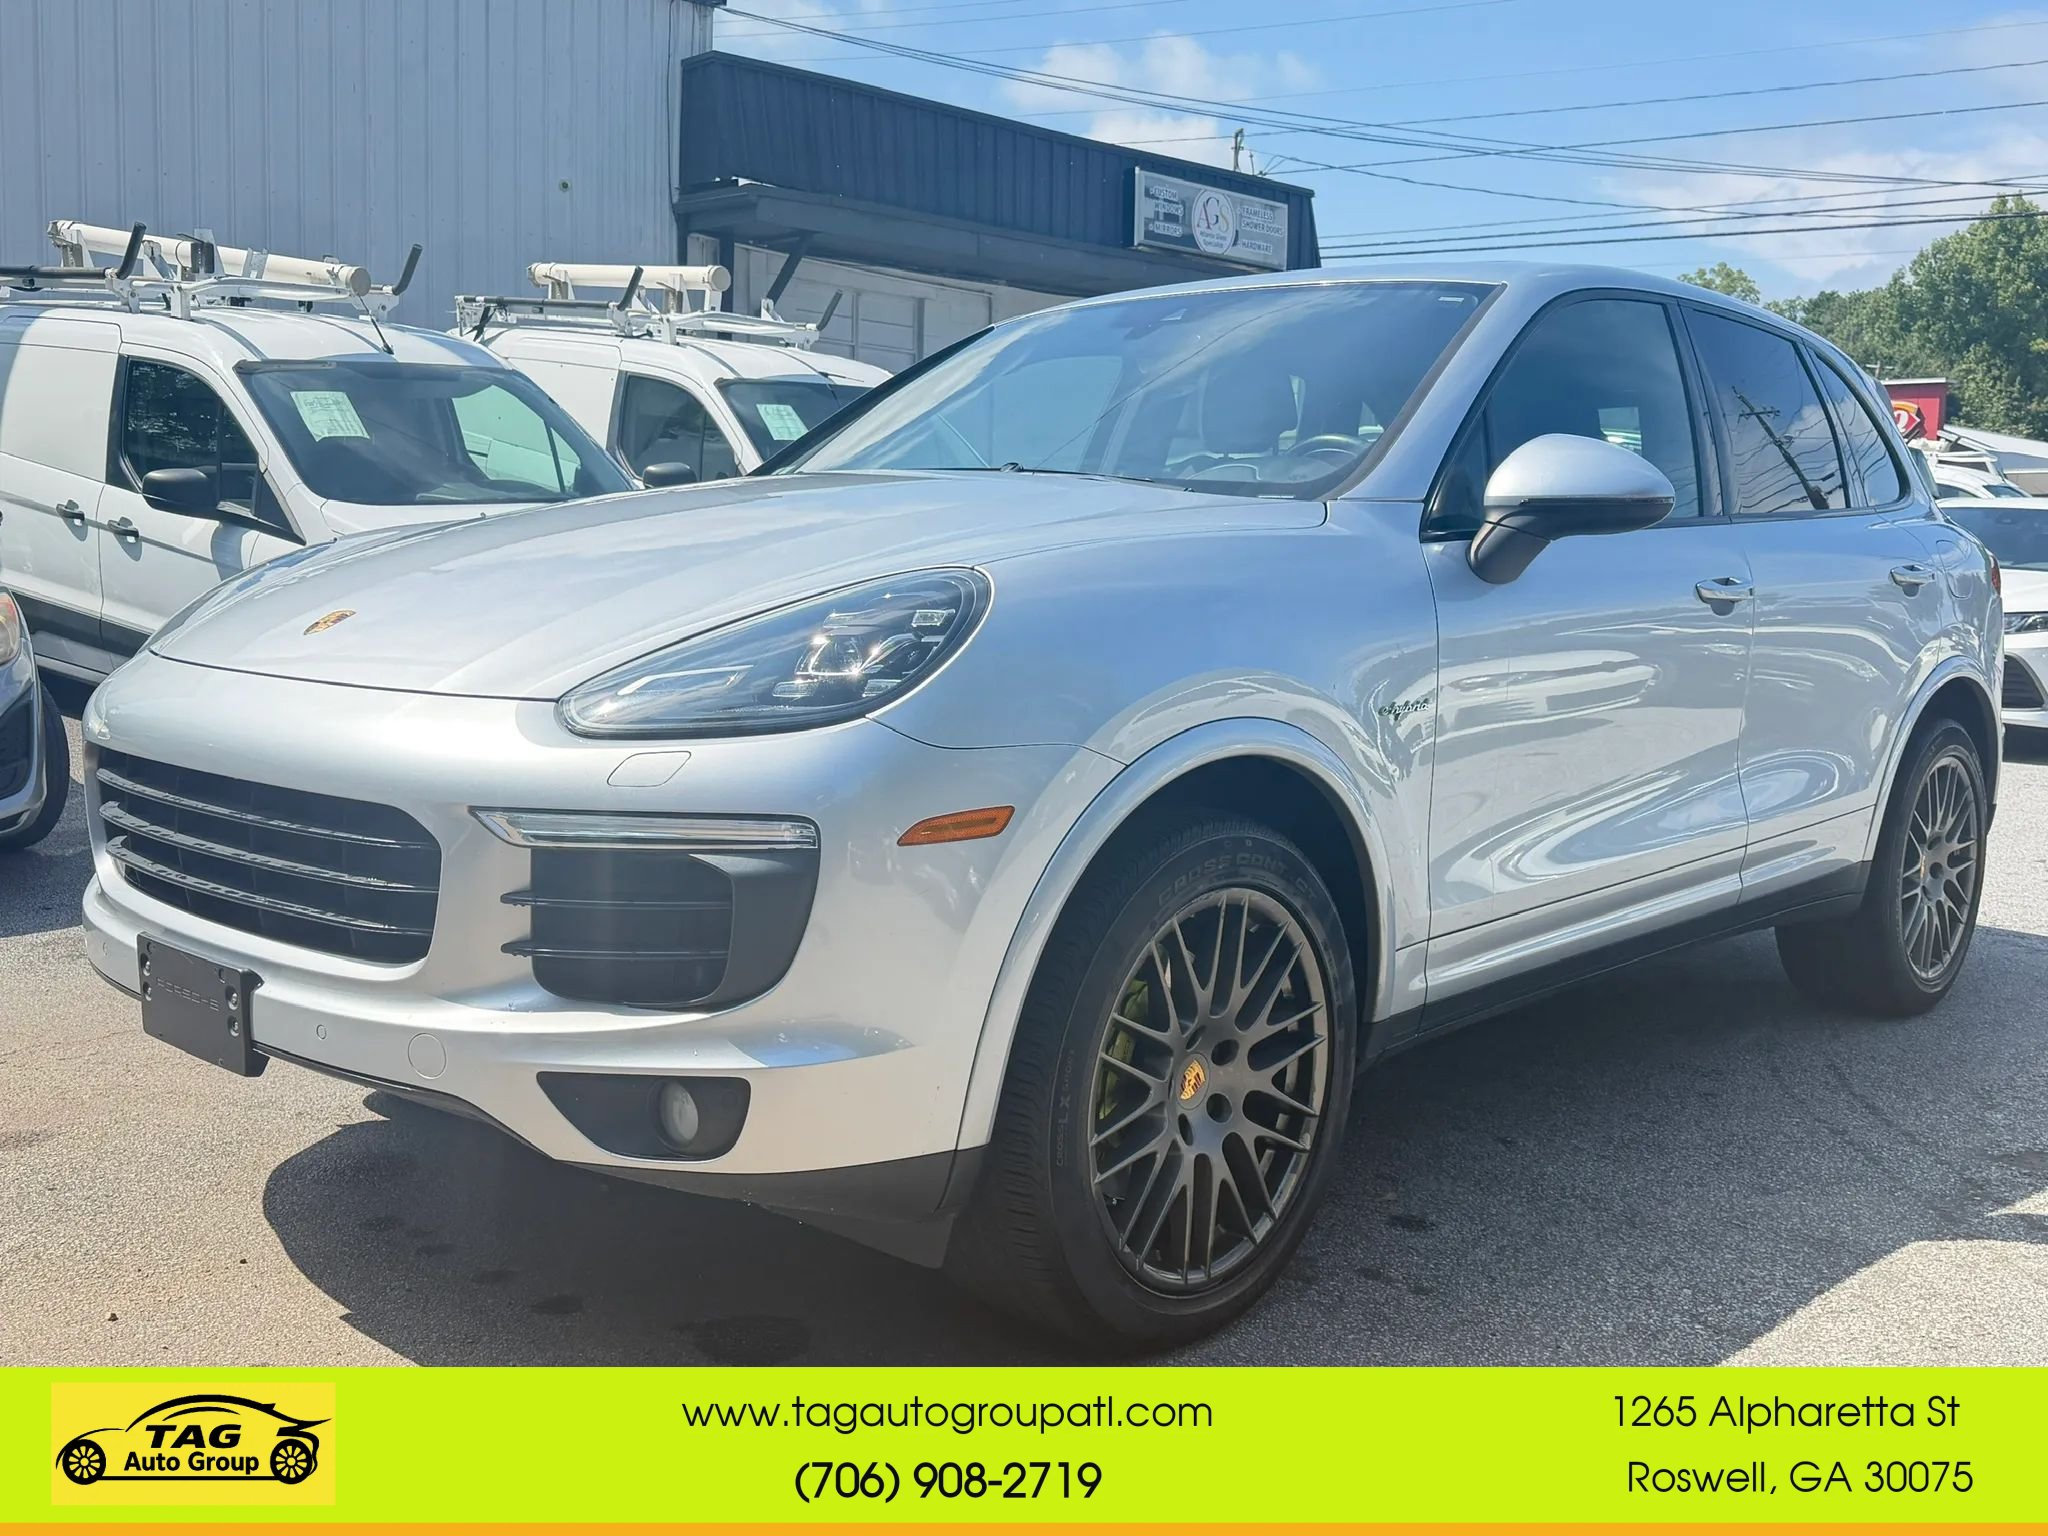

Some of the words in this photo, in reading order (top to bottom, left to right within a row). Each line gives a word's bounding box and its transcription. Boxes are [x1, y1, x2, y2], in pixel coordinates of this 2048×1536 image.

[1153, 186, 1178, 200] CUSTOM
[1154, 201, 1184, 216] WINDOWS
[1197, 196, 1230, 233] AGS
[1242, 206, 1273, 221] FRAMELESS
[1154, 222, 1182, 236] MIRRORS
[1241, 219, 1265, 231] SHOWER
[1265, 224, 1284, 237] DOORS
[1241, 239, 1273, 254] HARDWARE
